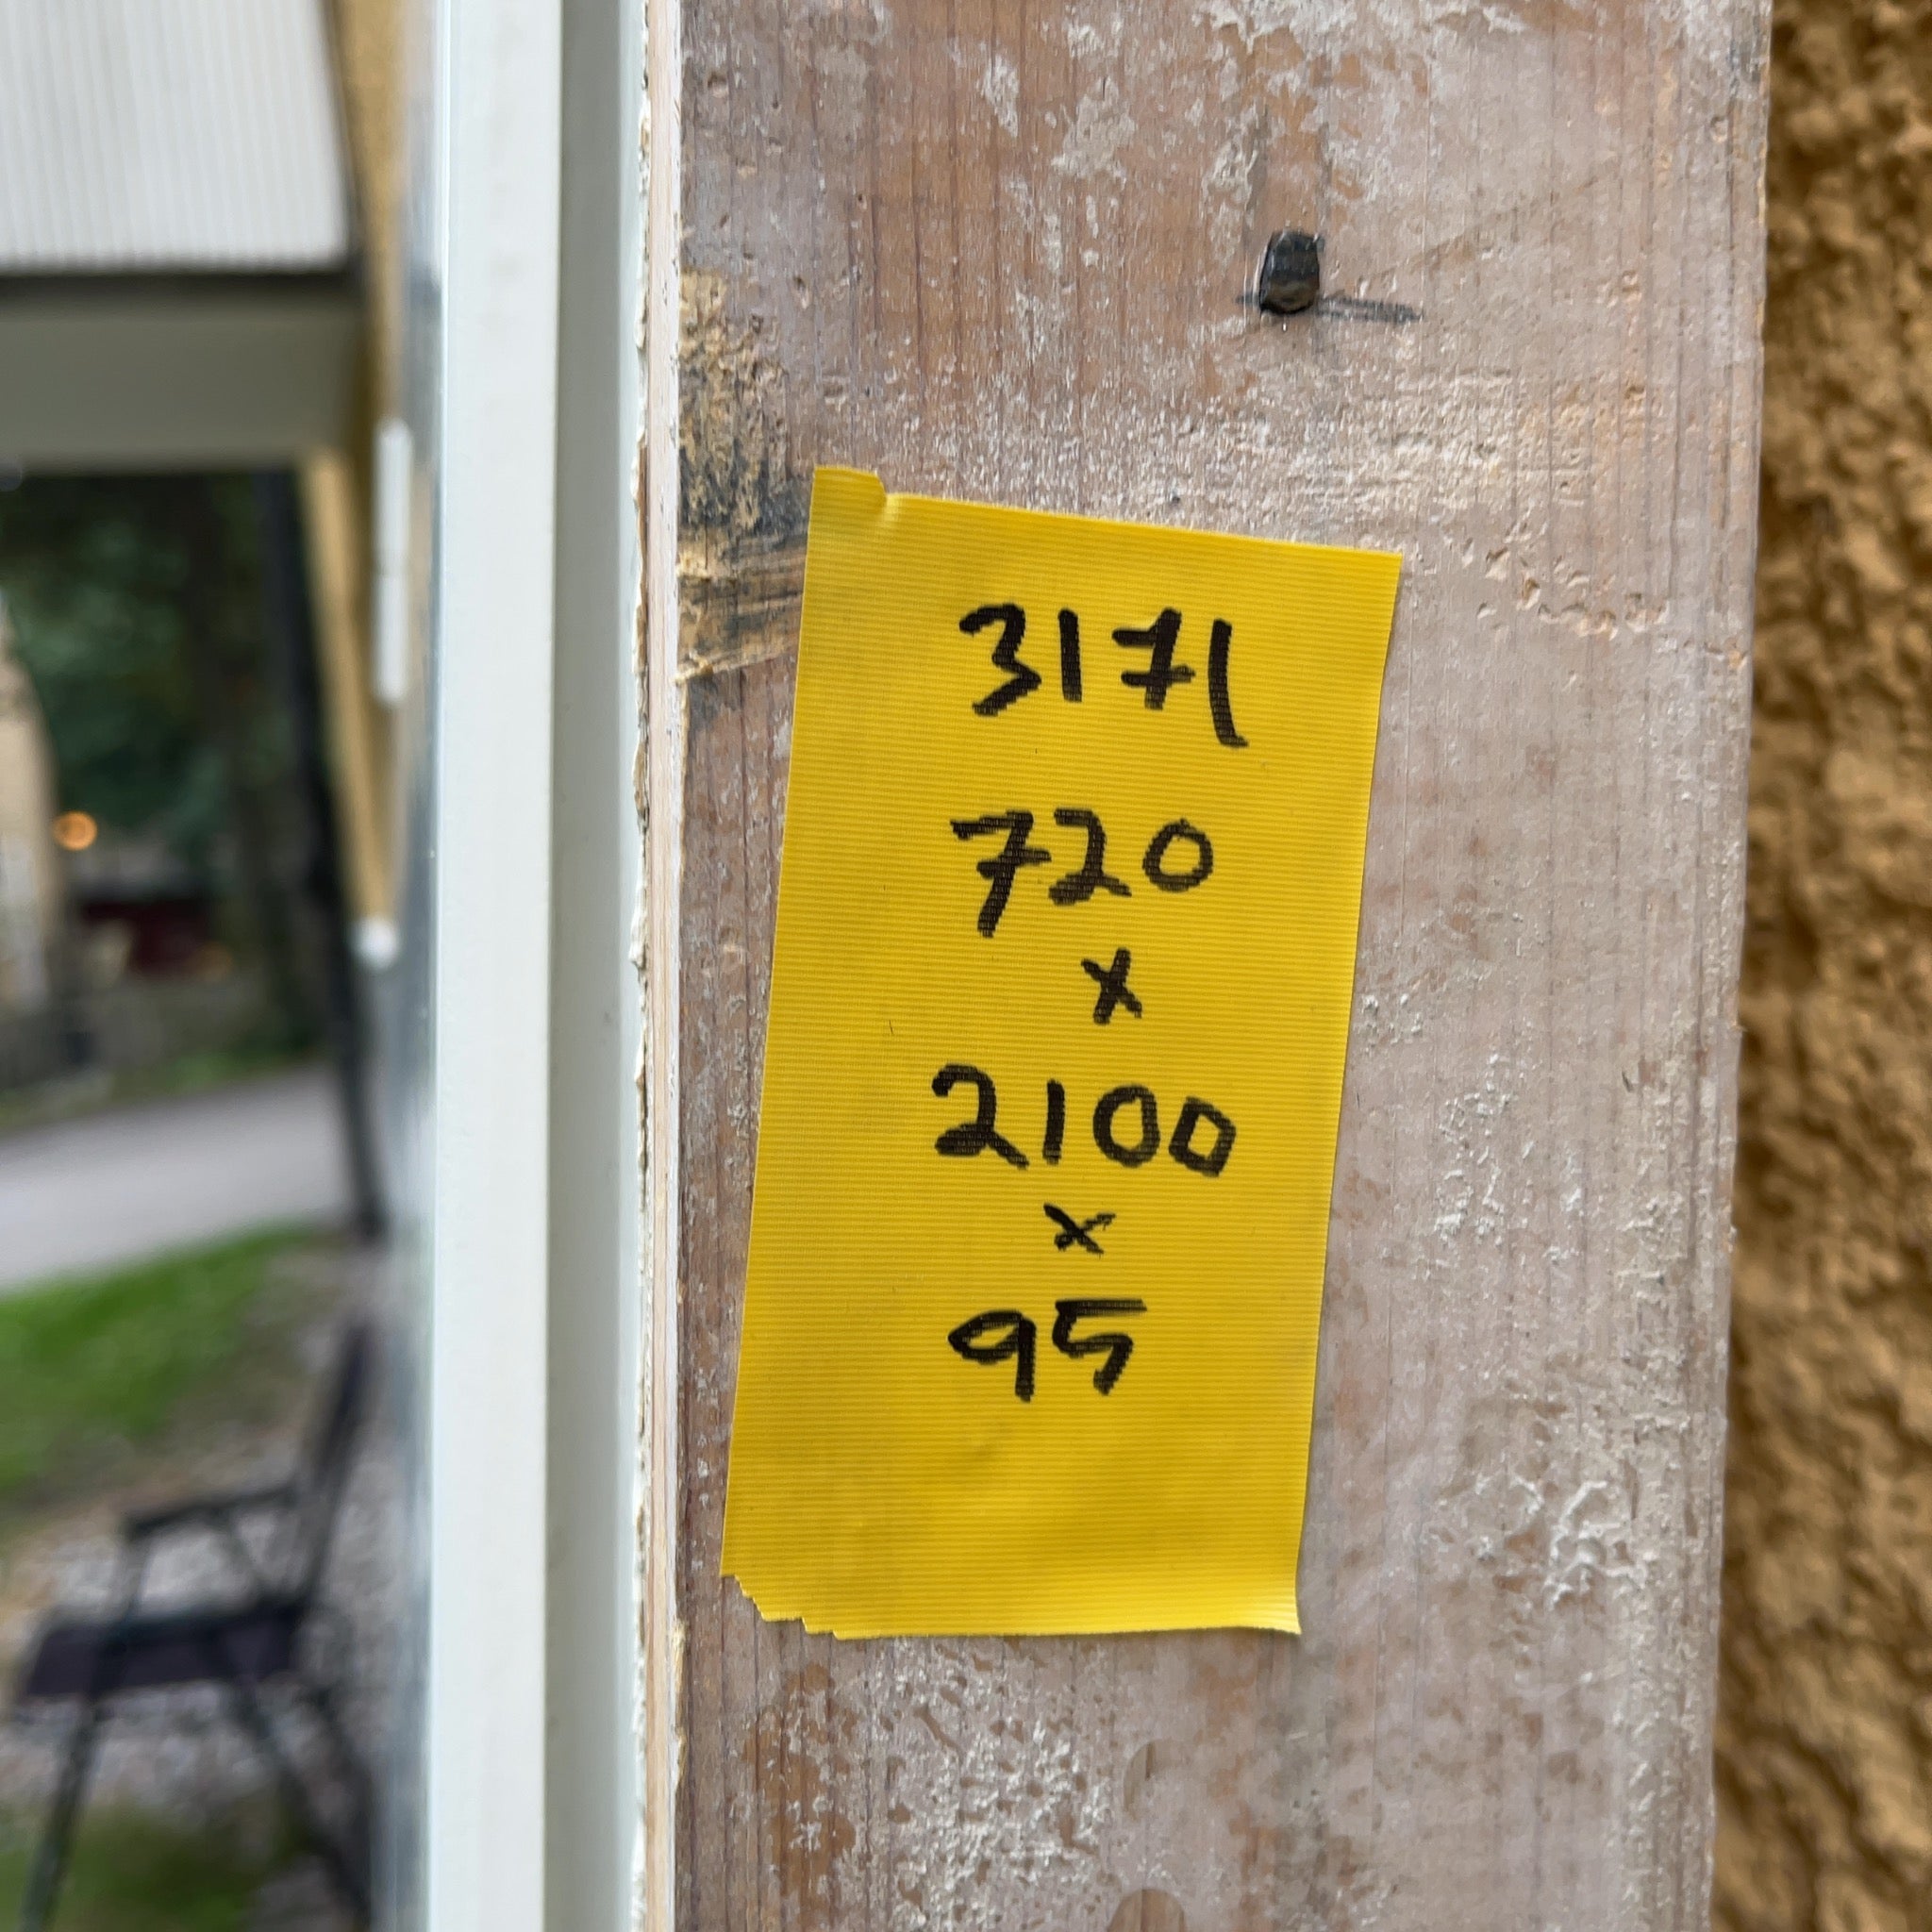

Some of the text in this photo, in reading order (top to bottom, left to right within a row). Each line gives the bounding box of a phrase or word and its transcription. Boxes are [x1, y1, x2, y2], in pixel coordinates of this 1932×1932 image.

[958, 603, 1248, 748] 3171
[950, 808, 1214, 939] 720
[931, 1063, 1237, 1177] 2100
[947, 1298, 1147, 1403] 95
